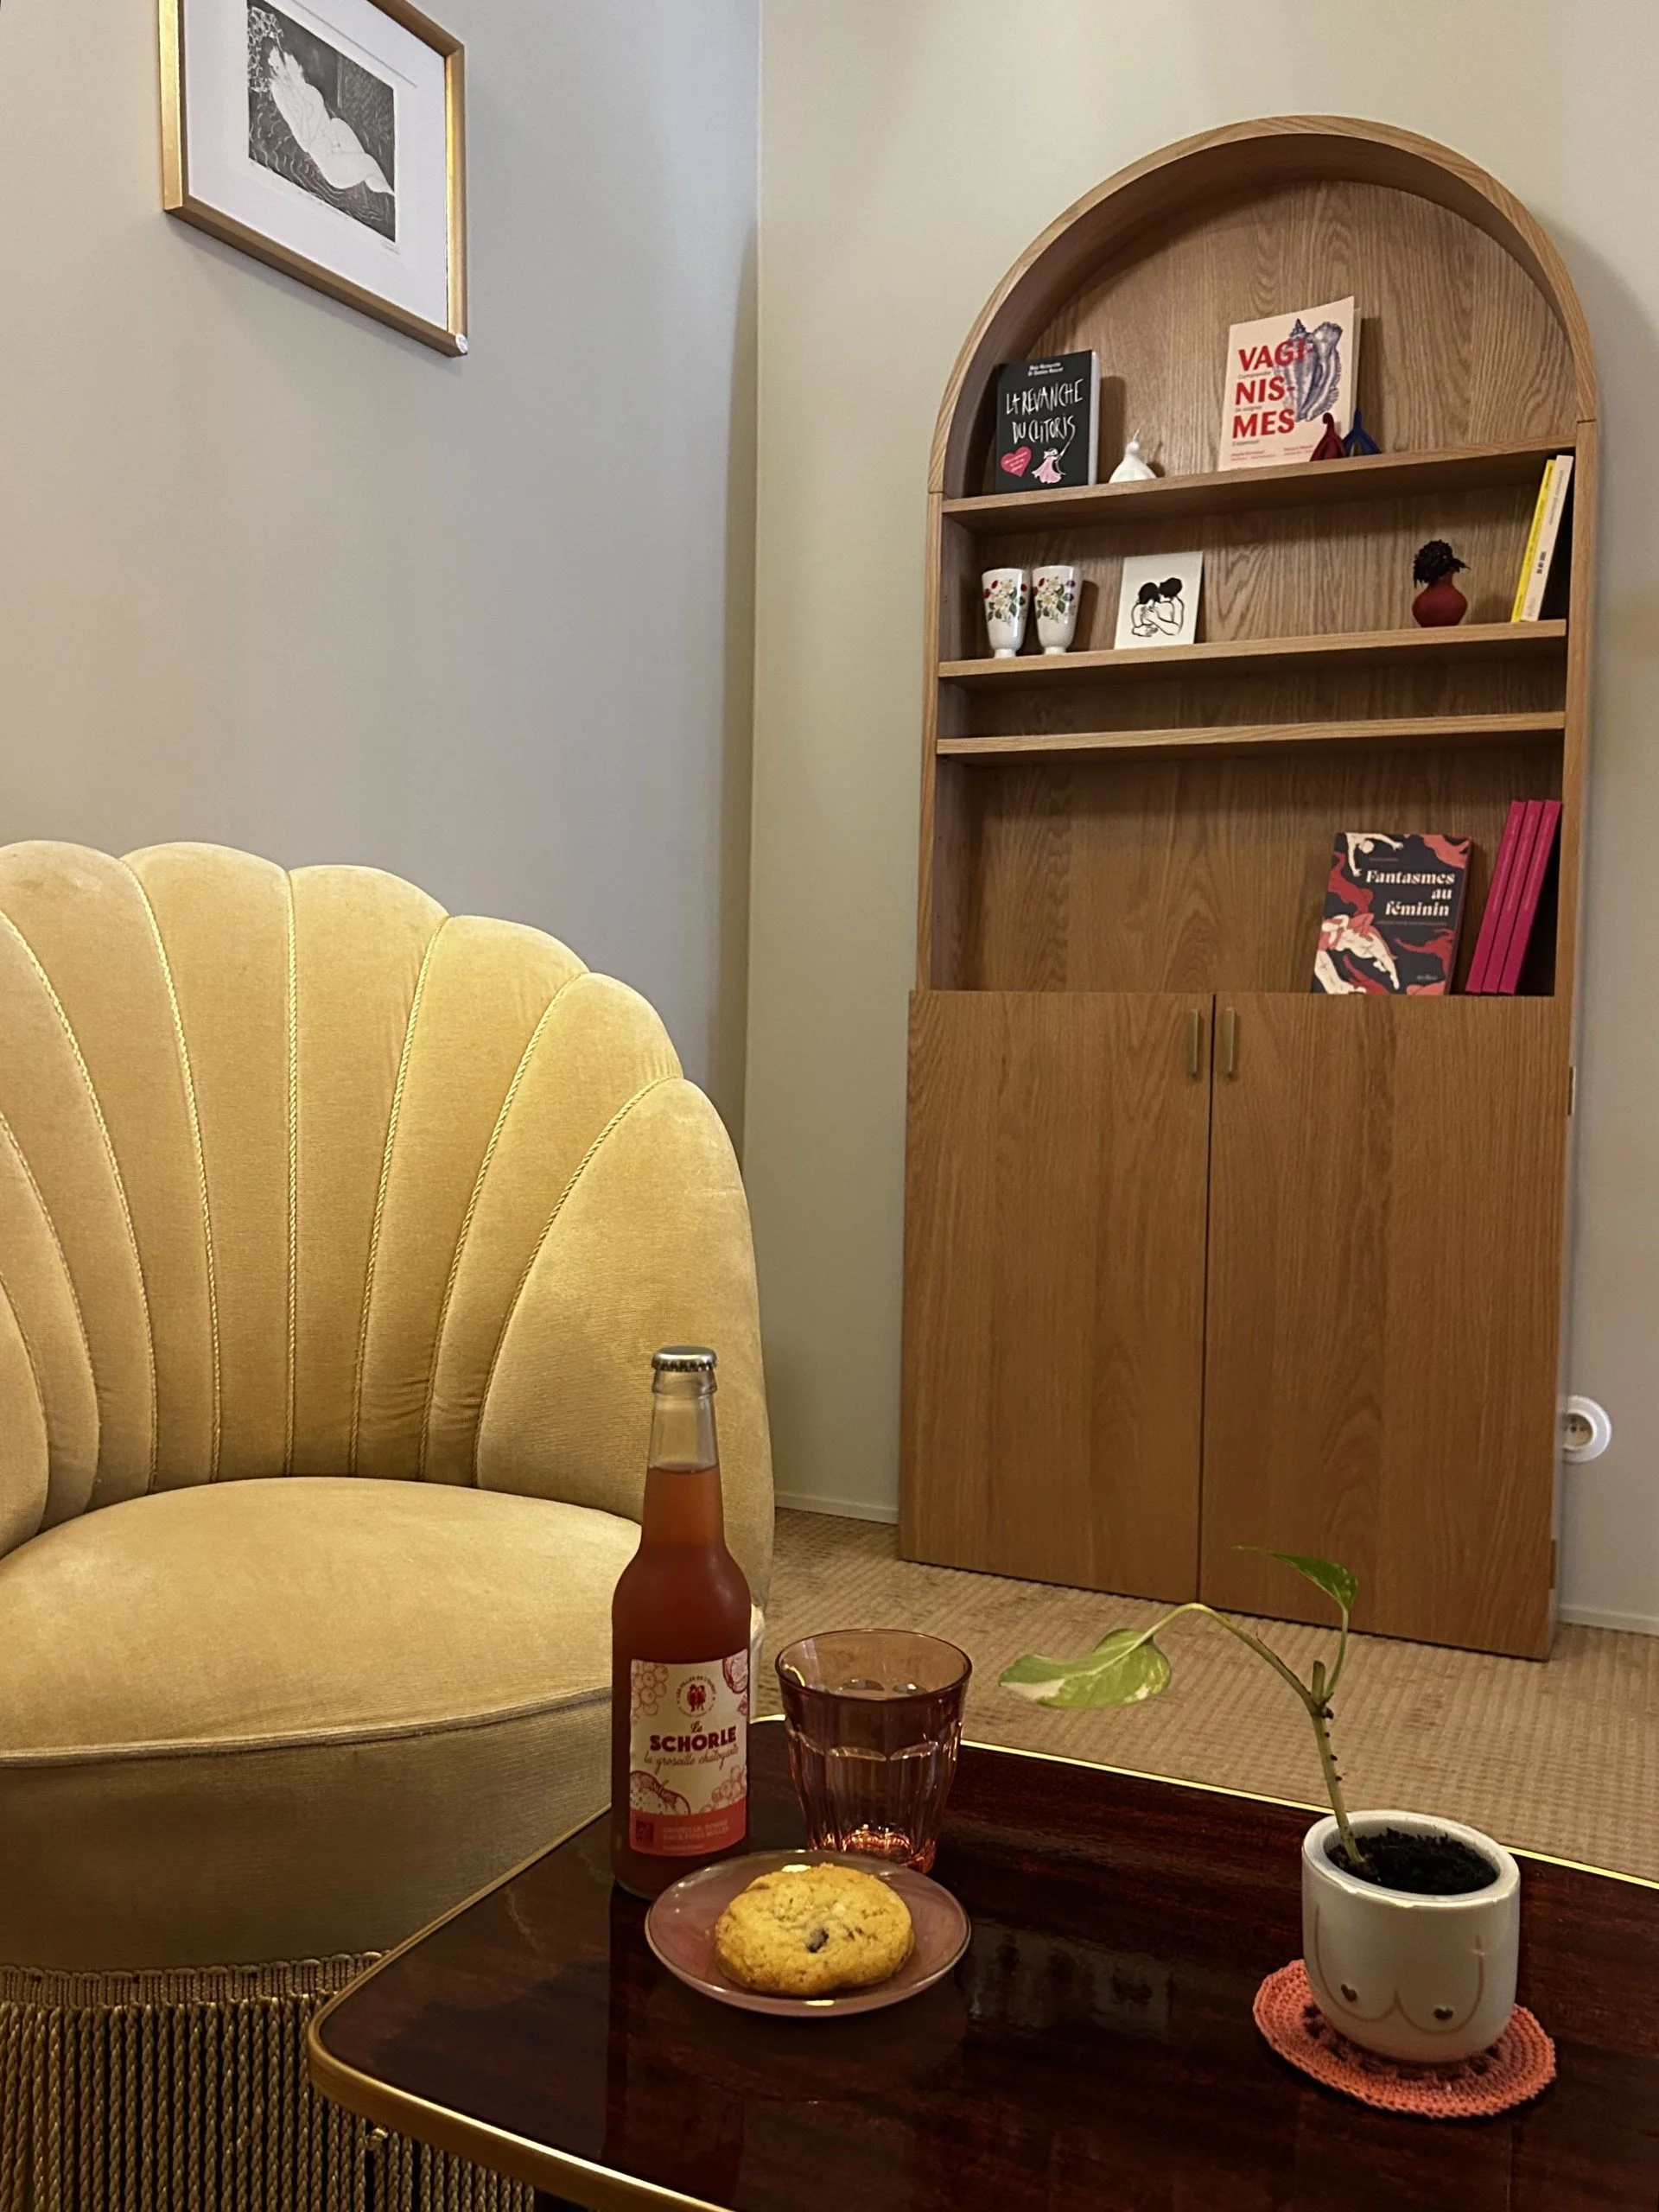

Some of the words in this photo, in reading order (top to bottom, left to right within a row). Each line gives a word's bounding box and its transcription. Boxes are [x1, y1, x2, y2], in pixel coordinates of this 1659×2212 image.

[1006, 392, 1020, 415] LA
[1021, 378, 1084, 416] REVANCHE
[1236, 375, 1295, 405] NIS-
[1012, 421, 1027, 445] DU
[1232, 409, 1294, 439] MES
[1366, 869, 1455, 885] Fantasmes
[1431, 888, 1452, 900] au
[1385, 900, 1450, 916] féminin
[650, 1725, 737, 1752] SCHORLE
